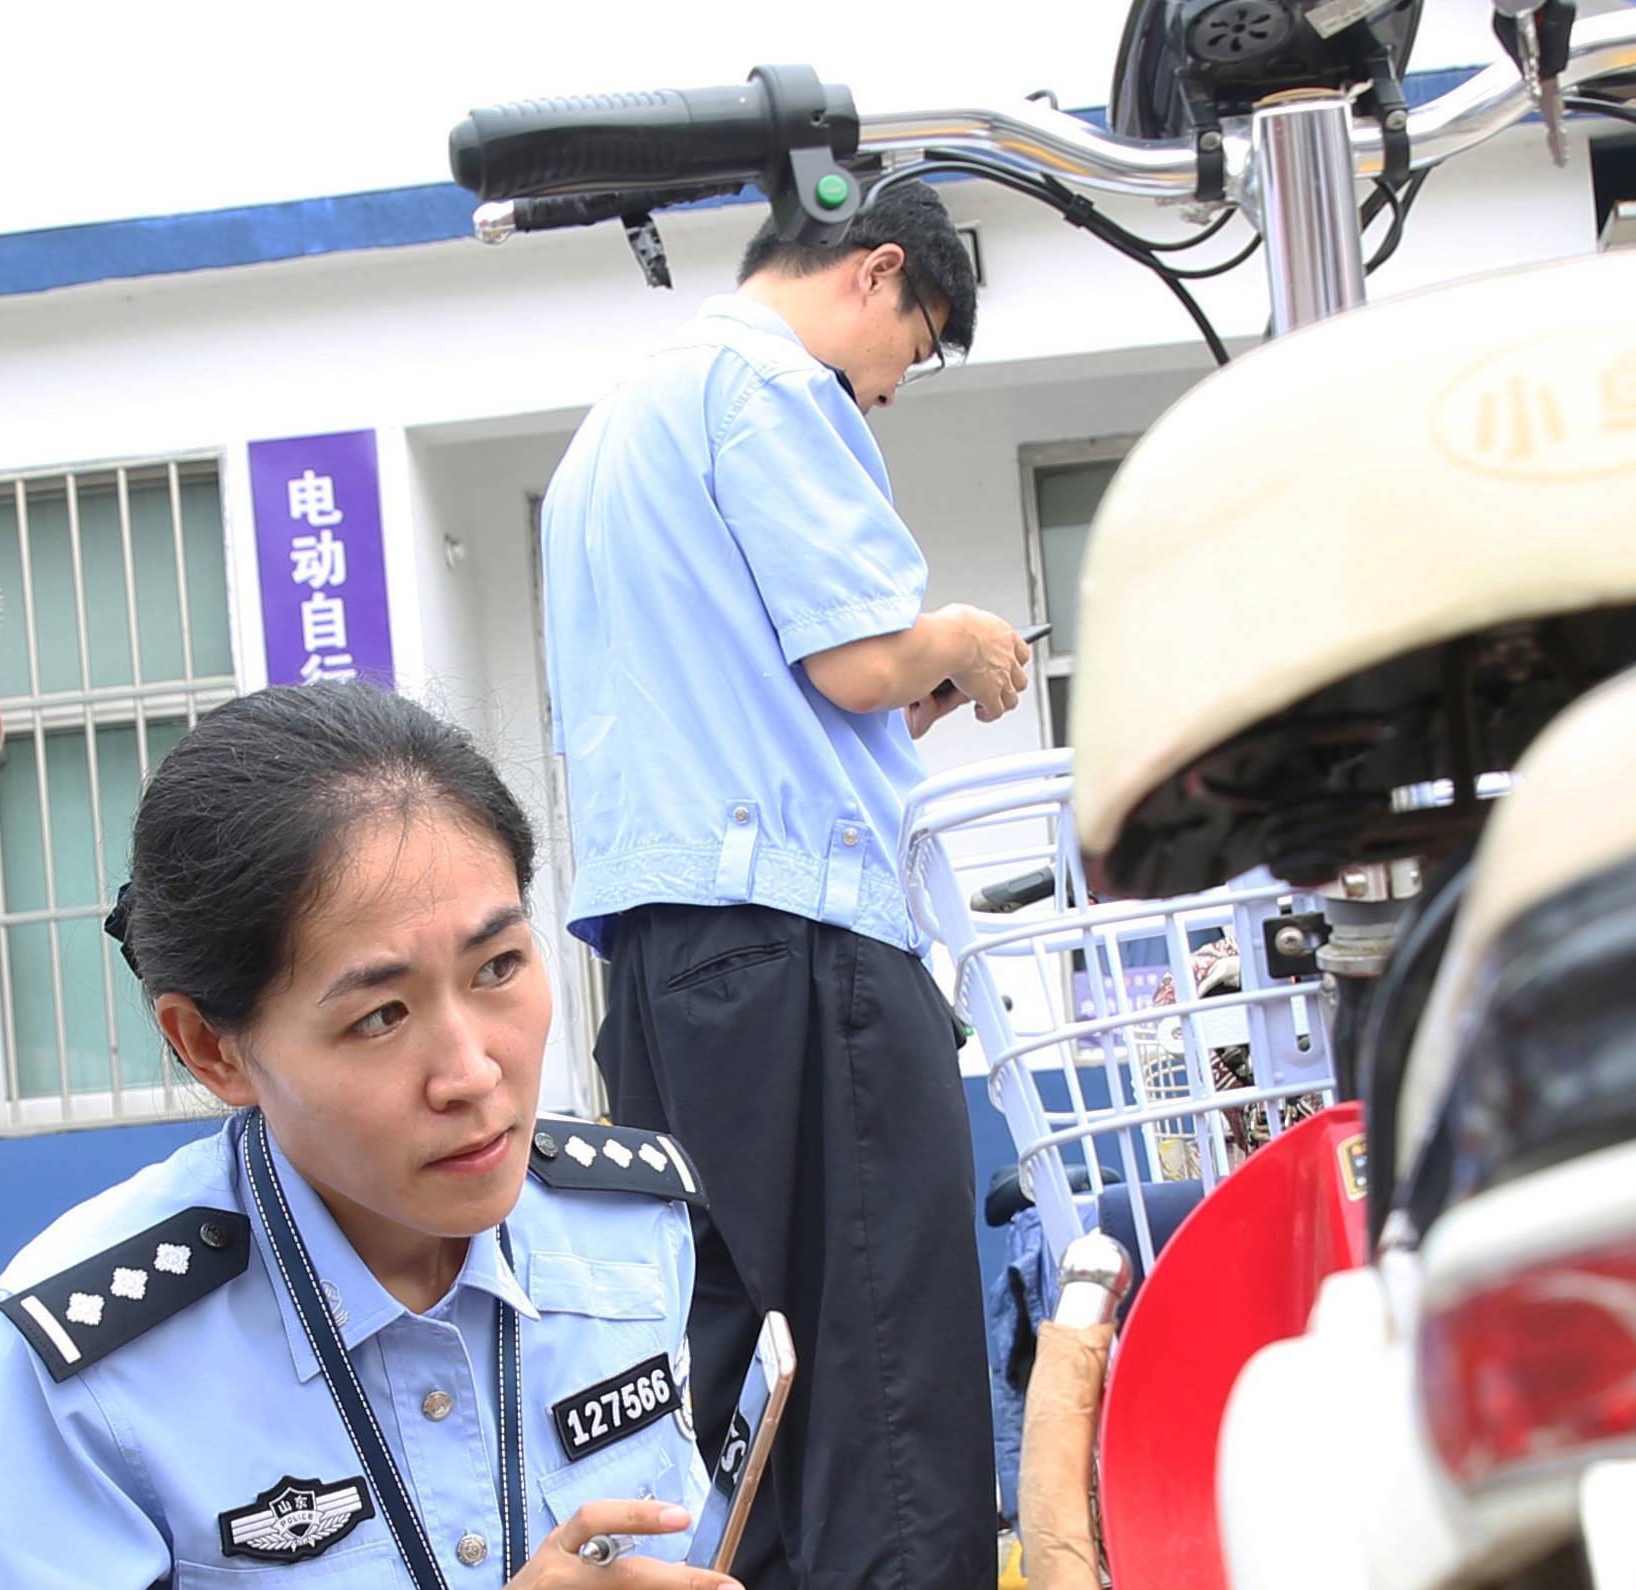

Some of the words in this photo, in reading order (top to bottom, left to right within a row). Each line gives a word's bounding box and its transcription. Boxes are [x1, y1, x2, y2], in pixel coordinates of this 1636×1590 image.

[566, 1368, 672, 1447] 127566
[276, 1494, 309, 1515] 山东
[280, 1513, 315, 1528] POLICE
